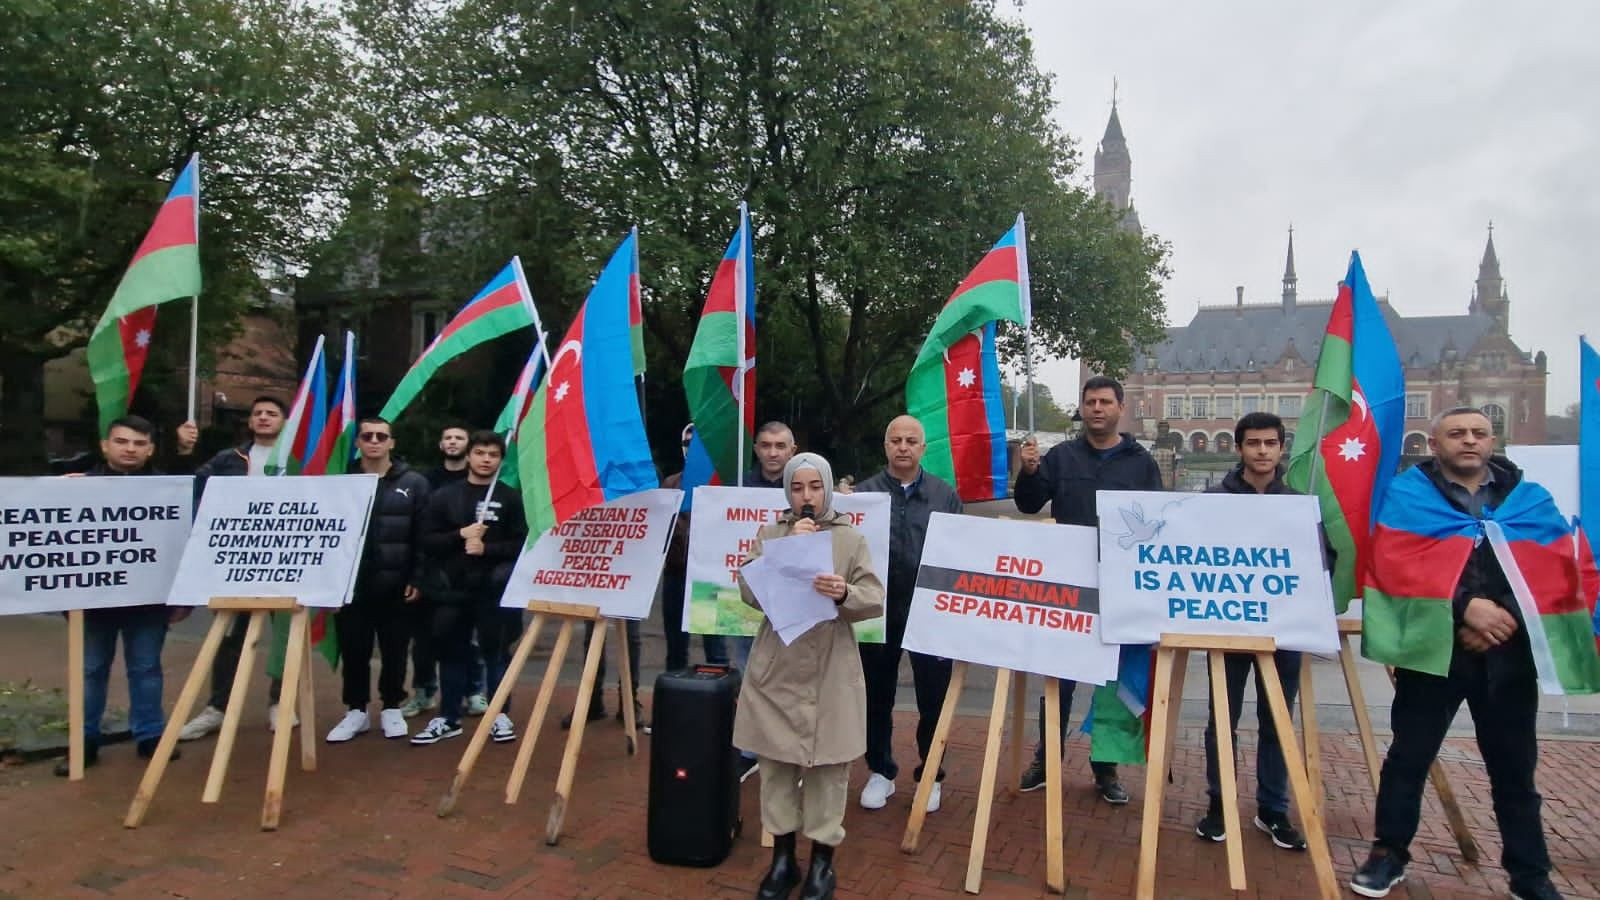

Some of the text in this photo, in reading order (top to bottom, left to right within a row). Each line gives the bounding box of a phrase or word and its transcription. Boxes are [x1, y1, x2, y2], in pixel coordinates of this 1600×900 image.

[0, 505, 180, 524] EATE A MORE
[248, 502, 319, 515] WE CALL
[570, 507, 648, 522] REVAN IS
[726, 508, 769, 522] MINE
[210, 518, 347, 532] INTERNATIONAL
[550, 523, 648, 539] NOT SERIOUS
[9, 527, 143, 547] PEACEFUL
[208, 534, 341, 548] COMMUNITY TO
[560, 539, 625, 555] ABOUT A
[1138, 544, 1291, 568] KARABAKH
[0, 548, 157, 570] WORLD FOR
[215, 551, 323, 565] STAND WITH
[562, 555, 613, 571] PEACE
[996, 555, 1043, 577] END
[25, 570, 128, 591] FUTURE
[225, 568, 303, 582] JUSTICE!
[533, 569, 631, 590] AGREEMENT
[1134, 570, 1299, 596] IS A WAY OF
[954, 573, 1080, 608] ARMENIAN
[934, 593, 1093, 634] SEPARATISM!
[1168, 598, 1268, 623] PEACE!
